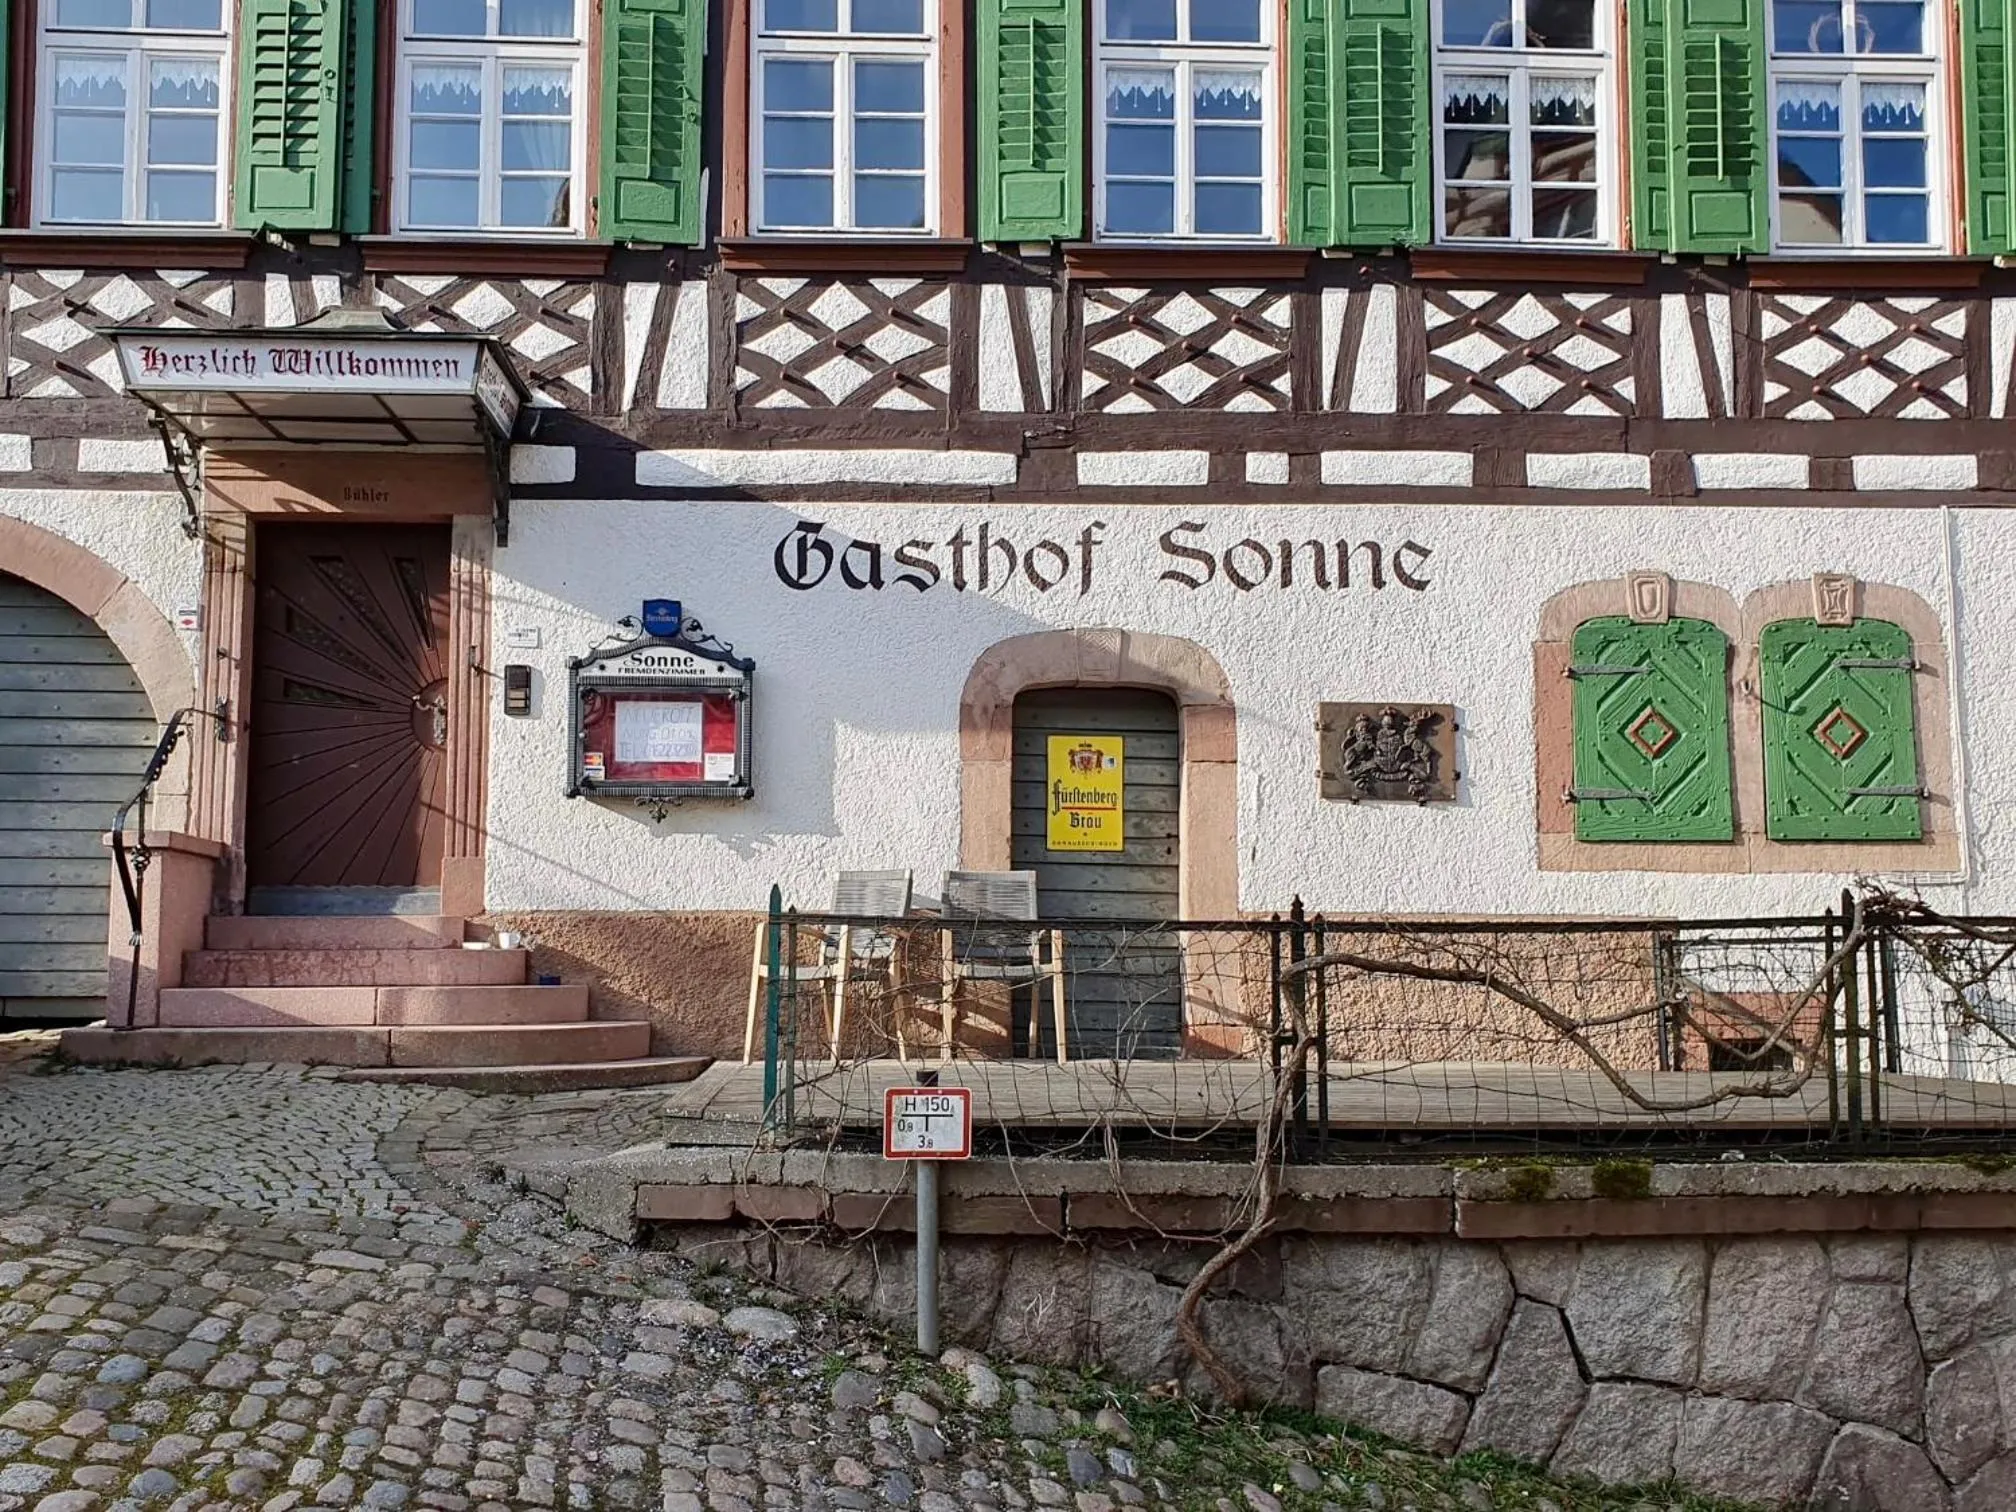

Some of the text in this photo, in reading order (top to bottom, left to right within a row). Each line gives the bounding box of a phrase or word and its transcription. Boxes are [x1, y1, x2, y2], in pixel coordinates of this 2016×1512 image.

[139, 346, 461, 379] Herzlich Willkommen
[774, 521, 1434, 598] Gasthof Sonne
[623, 652, 695, 668] Sonne
[618, 667, 706, 675] FREMDENZIMMER
[1052, 778, 1118, 816] Fürstenberg
[1069, 811, 1102, 829] Bräu
[905, 1096, 950, 1112] H 150
